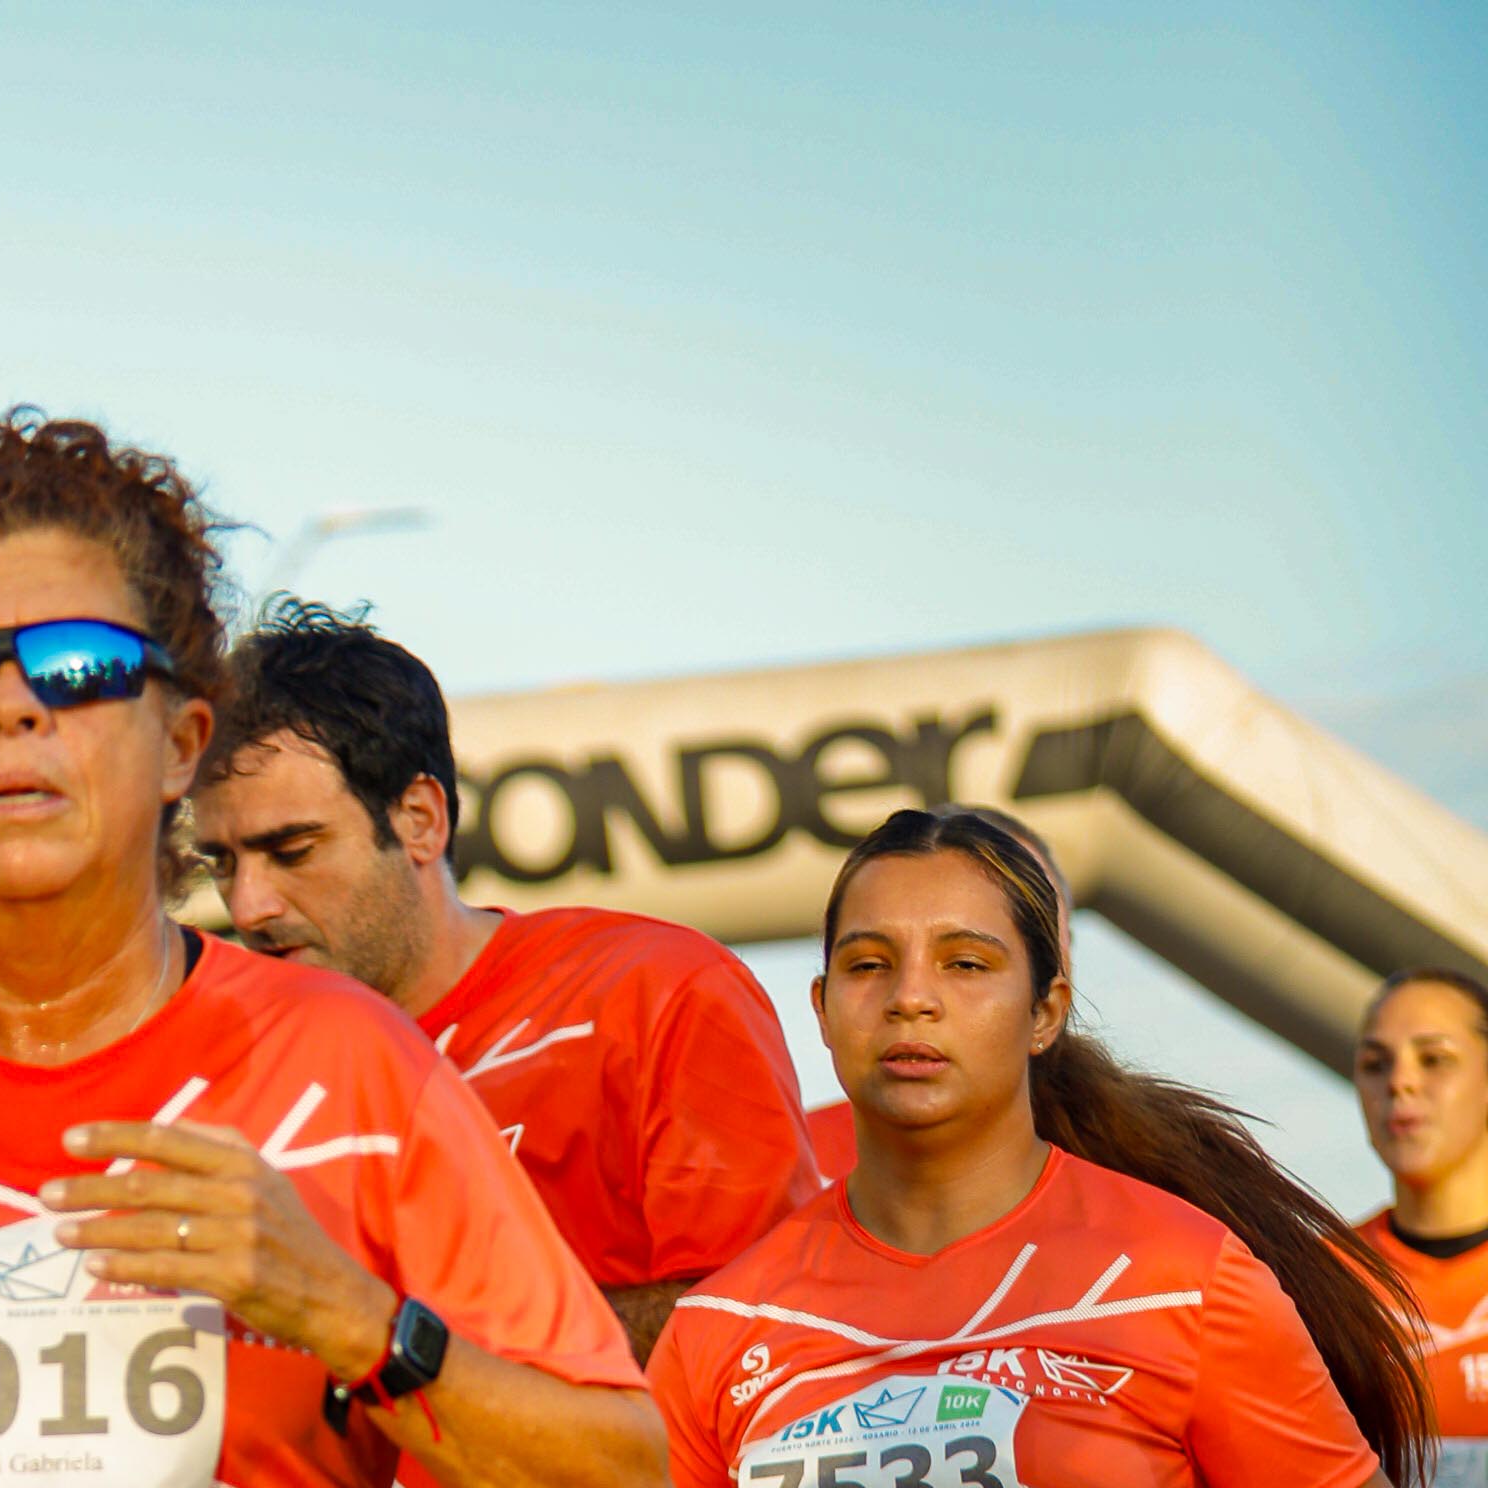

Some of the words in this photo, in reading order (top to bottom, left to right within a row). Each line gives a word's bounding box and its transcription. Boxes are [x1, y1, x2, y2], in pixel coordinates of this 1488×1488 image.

[936, 1347, 1027, 1377] 15K
[943, 1393, 981, 1410] 10K
[779, 1404, 848, 1442] 15K
[9, 1451, 104, 1473] Gabriela
